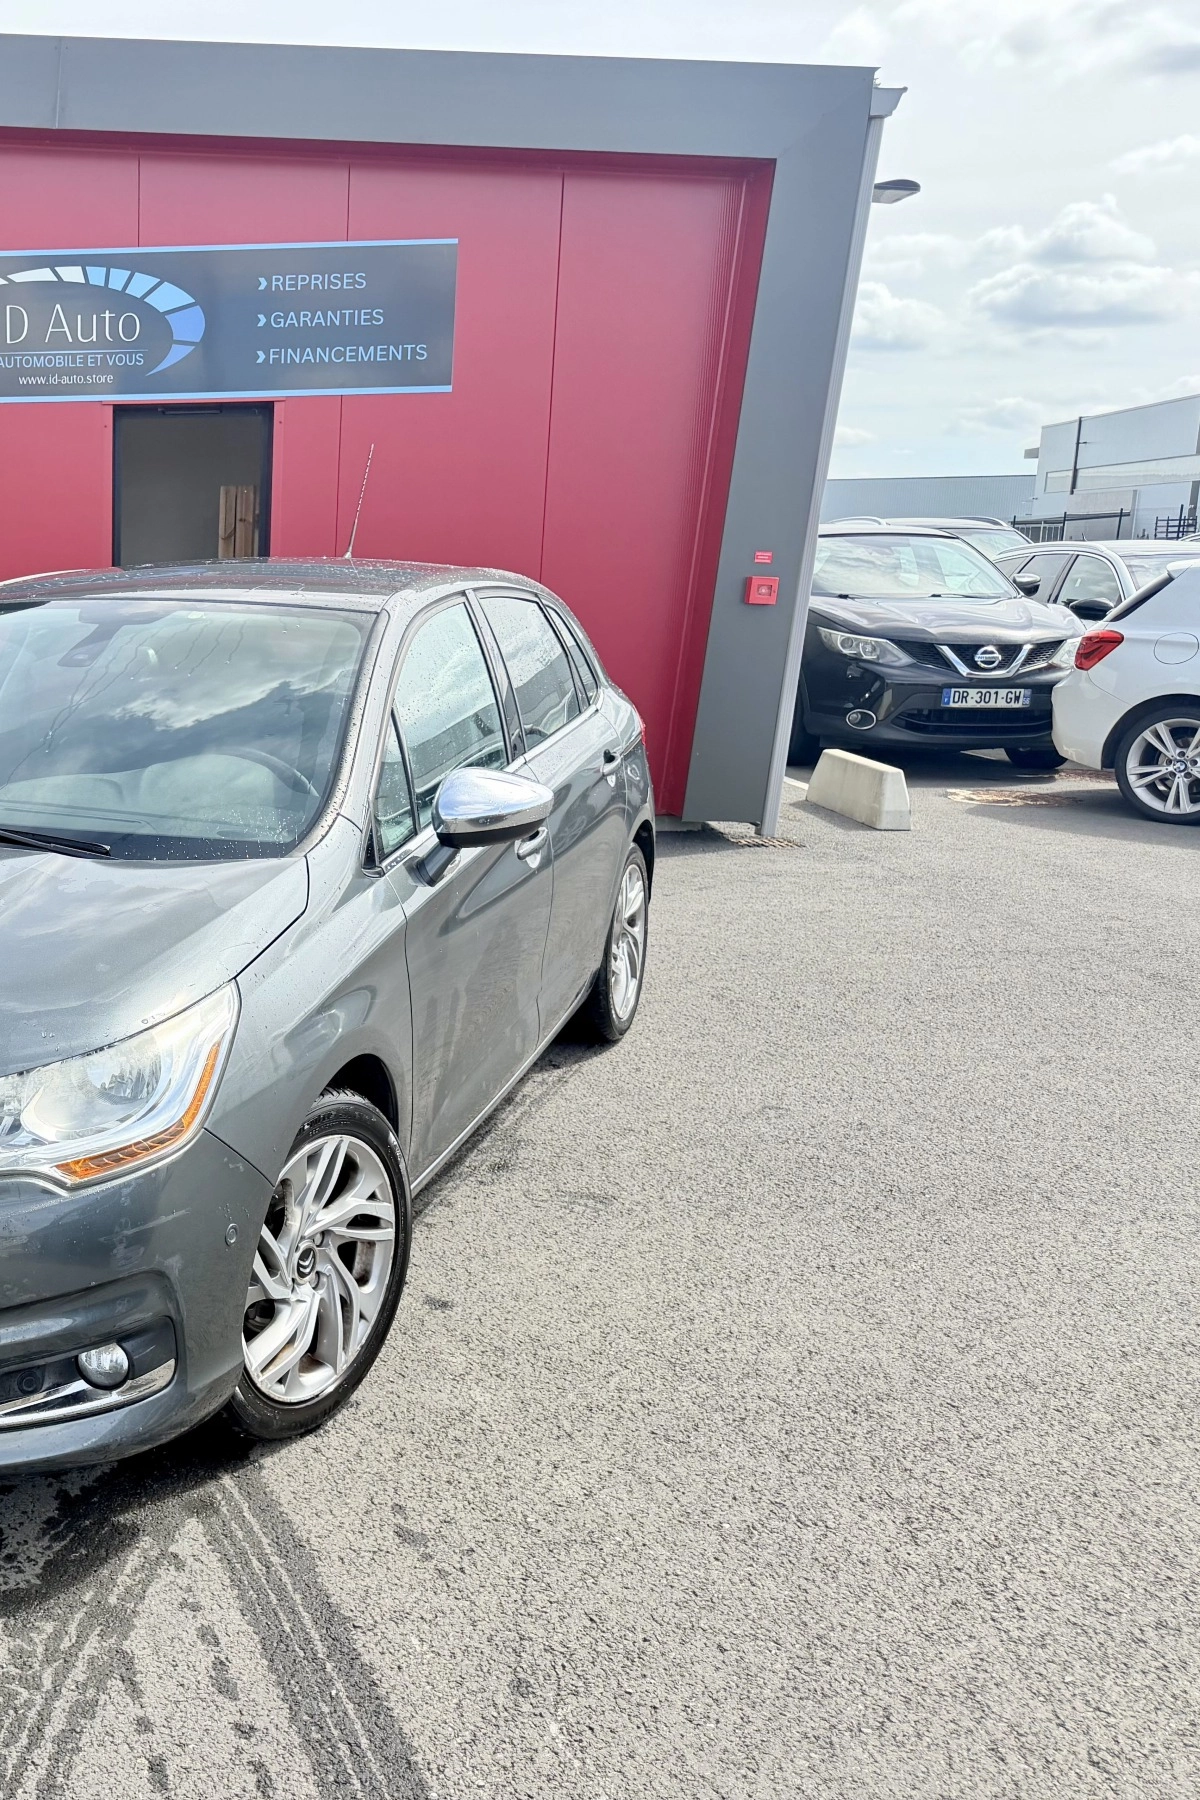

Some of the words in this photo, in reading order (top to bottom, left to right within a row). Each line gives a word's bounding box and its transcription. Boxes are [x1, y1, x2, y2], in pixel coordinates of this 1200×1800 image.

[271, 272, 367, 292] REPRISES
[44, 303, 141, 343] Auto
[270, 308, 384, 328] GARANTIES
[87, 354, 103, 367] ET
[106, 353, 144, 366] VOUS
[268, 344, 428, 365] FINANCEMENTS
[18, 373, 114, 385] www.id-auto.store
[952, 690, 1022, 705] DR-301-GW
